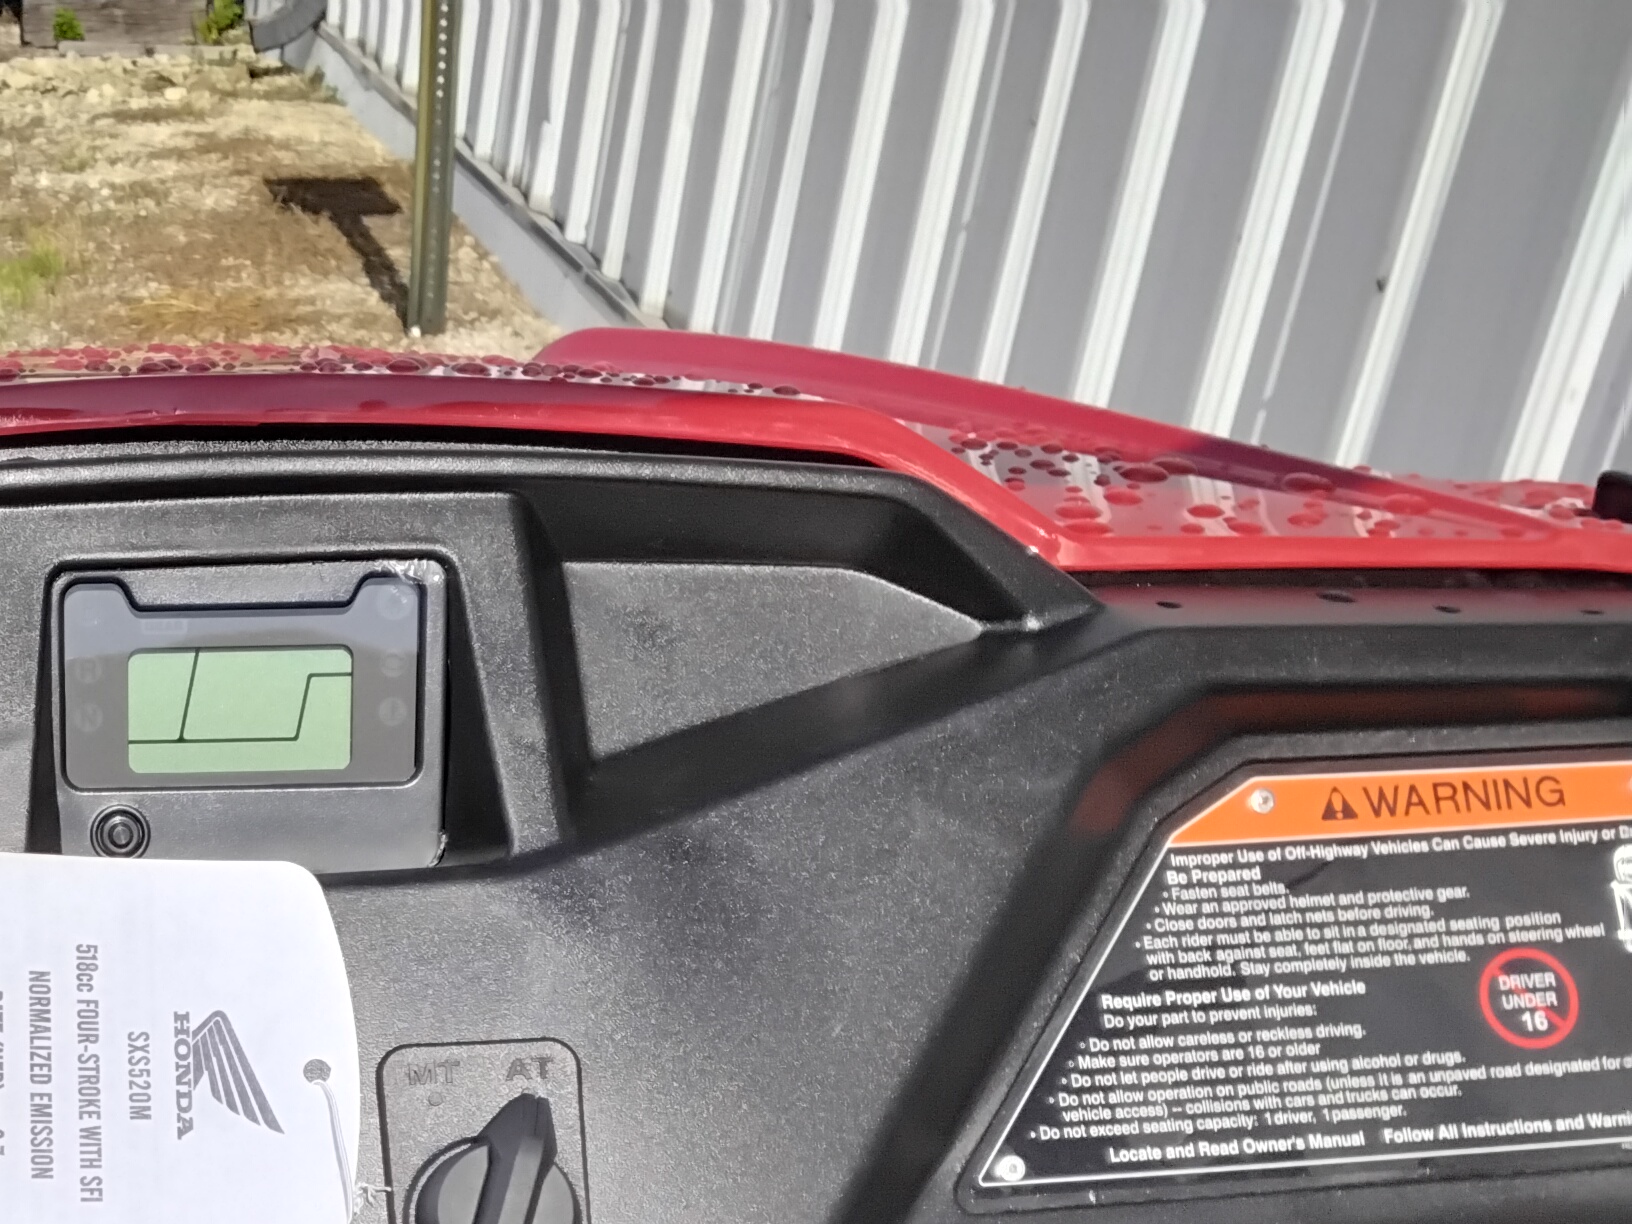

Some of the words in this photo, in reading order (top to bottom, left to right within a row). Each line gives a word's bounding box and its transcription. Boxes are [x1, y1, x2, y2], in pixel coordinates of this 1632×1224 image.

[1362, 776, 1566, 818] WARNING
[1171, 853, 1233, 868] Improper
[1237, 849, 1264, 863] Use
[1269, 847, 1281, 861] of
[1285, 843, 1368, 860] Off-Highway
[1371, 839, 1428, 854] Vehicles
[1432, 837, 1459, 851] Can
[1463, 835, 1506, 849] Cause
[1509, 832, 1556, 846] Severe
[1560, 829, 1598, 844] Injury
[1602, 829, 1615, 840] or
[1168, 871, 1187, 884] Be
[1192, 866, 1261, 884] Prepared
[1163, 902, 1197, 915] Wear
[1202, 903, 1218, 913] an
[1223, 896, 1286, 913] approved
[1290, 894, 1335, 907] helmet
[1340, 891, 1364, 904] and
[1368, 888, 1433, 905] protective
[1437, 888, 1469, 901] gear.
[1172, 887, 1217, 900] Fasten
[1221, 884, 1249, 897] seat
[1253, 882, 1289, 895] belts.
[1155, 919, 1193, 932] Close
[1198, 917, 1237, 929] doors
[1241, 913, 1266, 927] and
[1270, 911, 1302, 925] latch
[1306, 911, 1334, 923] nets
[1338, 908, 1380, 921] before
[1385, 904, 1434, 918] driving.
[76, 943, 98, 992] 518cc
[1150, 971, 1163, 981] or
[1167, 964, 1236, 980] handhold.
[1240, 963, 1269, 976] Stay
[1274, 957, 1346, 974] completely
[1351, 954, 1390, 968] inside
[1394, 953, 1415, 966] the
[1419, 950, 1469, 964] vehicle.
[1101, 993, 1161, 1010] Require
[1166, 991, 1217, 1006] Proper
[1222, 988, 1250, 1002] Use
[1256, 986, 1269, 1000] of
[1273, 985, 1307, 998] Your
[1311, 980, 1366, 996] Vehicle
[1498, 972, 1556, 991] DRIVER
[1502, 991, 1558, 1010] UNDER
[28, 970, 52, 1085] NORMALIZED
[1104, 1015, 1124, 1028] Do
[1127, 1016, 1158, 1029] your
[1162, 1011, 1188, 1027] part
[1193, 1011, 1205, 1022] to
[1210, 1007, 1260, 1024] prevent
[1264, 1003, 1317, 1019] injuries:
[1522, 1010, 1548, 1032] 16
[1090, 1039, 1109, 1052] Do
[1113, 1038, 1135, 1050] not
[1139, 1035, 1174, 1049] allow
[1178, 1032, 1235, 1046] careless
[1238, 1032, 1252, 1042] or
[1256, 1027, 1312, 1041] reckless
[1316, 1023, 1366, 1037] driving.
[77, 1000, 101, 1120] FOUR-STROKE
[506, 1056, 553, 1080] AT
[1078, 1055, 1116, 1069] Make
[1119, 1056, 1149, 1067] sure
[1153, 1051, 1219, 1067] operators
[1222, 1050, 1244, 1060] are
[1249, 1046, 1264, 1059] 16
[1268, 1048, 1282, 1058] or
[1286, 1043, 1320, 1056] older
[128, 1031, 152, 1120] SXS520M
[174, 1012, 194, 1140] HONDA
[408, 1060, 460, 1085] MT
[30, 1093, 54, 1179] EMISSION
[1040, 1127, 1060, 1140] Do
[1064, 1126, 1086, 1138] not
[1090, 1121, 1139, 1137] exceed
[1143, 1119, 1193, 1133] seating
[1197, 1114, 1258, 1131] capacity:
[1265, 1113, 1271, 1125] 1
[1274, 1111, 1316, 1125] driver,
[1323, 1109, 1330, 1121] 1
[1332, 1107, 1406, 1123] passenger.
[1384, 1128, 1434, 1144] Follow
[1439, 1125, 1458, 1140] All
[1462, 1120, 1552, 1138] Instructions
[1556, 1116, 1584, 1131] and
[1587, 1113, 1632, 1129] Warni
[79, 1126, 102, 1168] WITH
[1110, 1148, 1162, 1163] Locate
[1166, 1144, 1194, 1159] and
[1199, 1141, 1238, 1157] Read
[1243, 1137, 1305, 1154] Owner's
[1309, 1132, 1365, 1149] Manual
[80, 1176, 103, 1202] SFI
